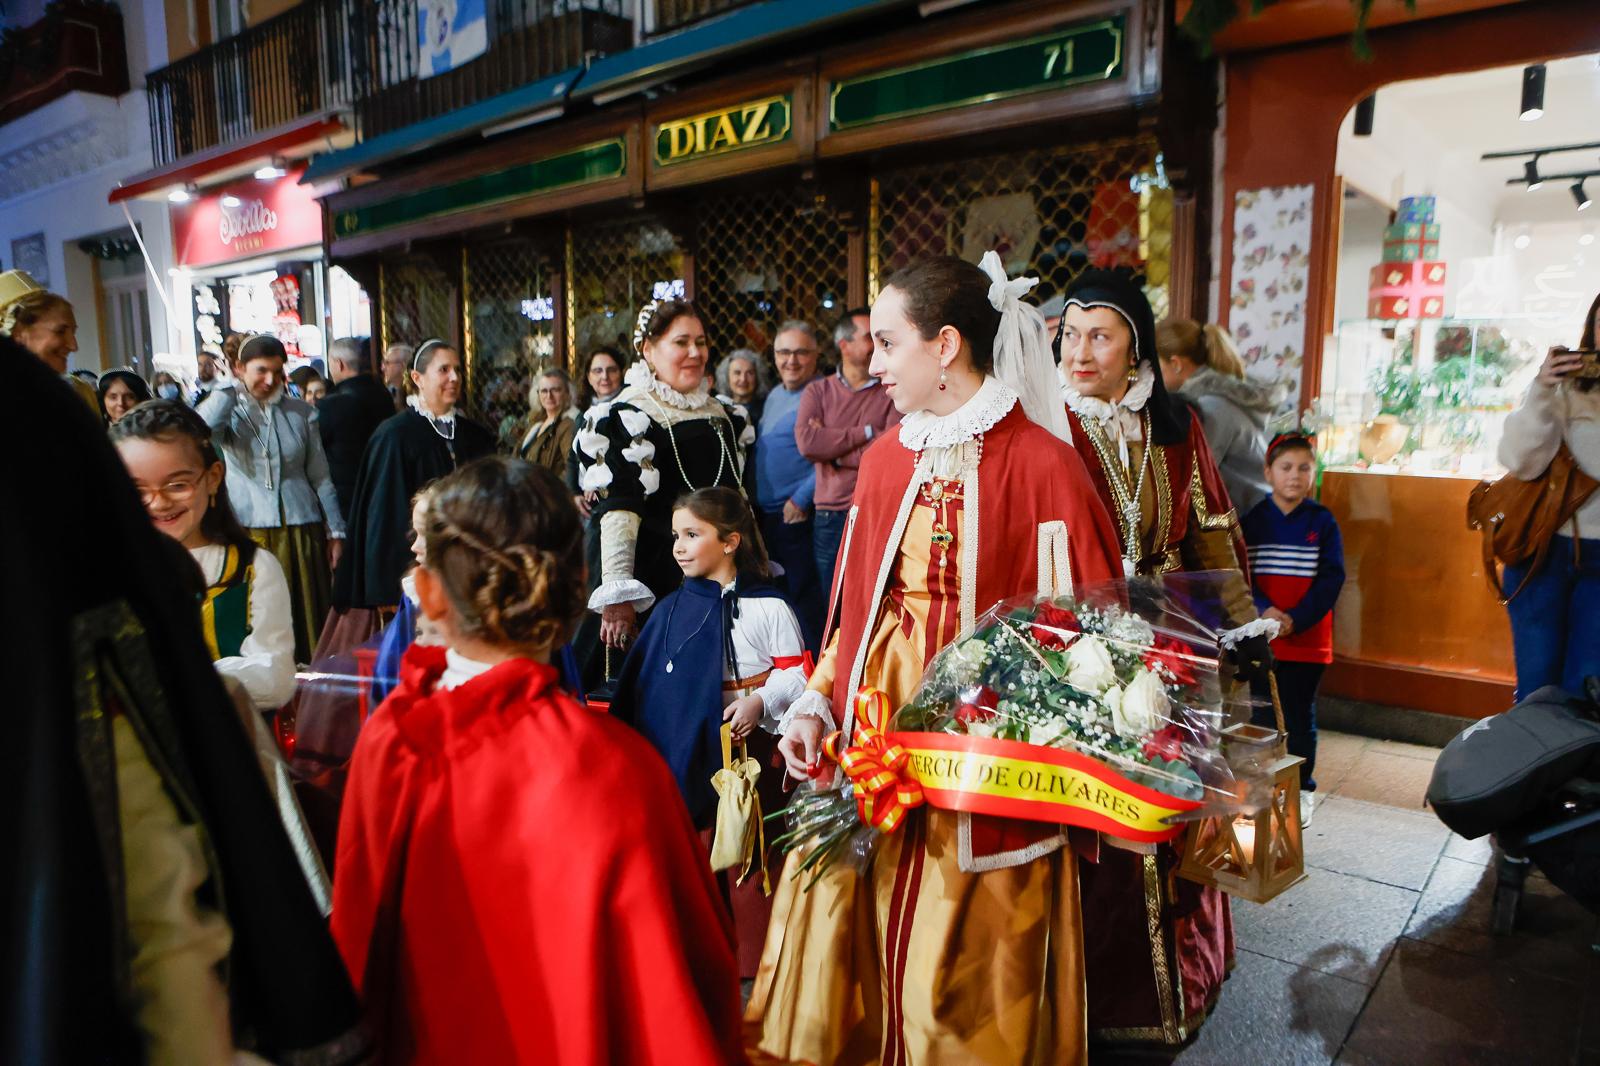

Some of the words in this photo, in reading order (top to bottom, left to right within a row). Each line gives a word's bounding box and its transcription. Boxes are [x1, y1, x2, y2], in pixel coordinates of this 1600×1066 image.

[1043, 40, 1075, 79] 71
[669, 102, 771, 159] DIAZ
[977, 762, 1011, 788] DE
[1018, 768, 1141, 822] OLIVARES
